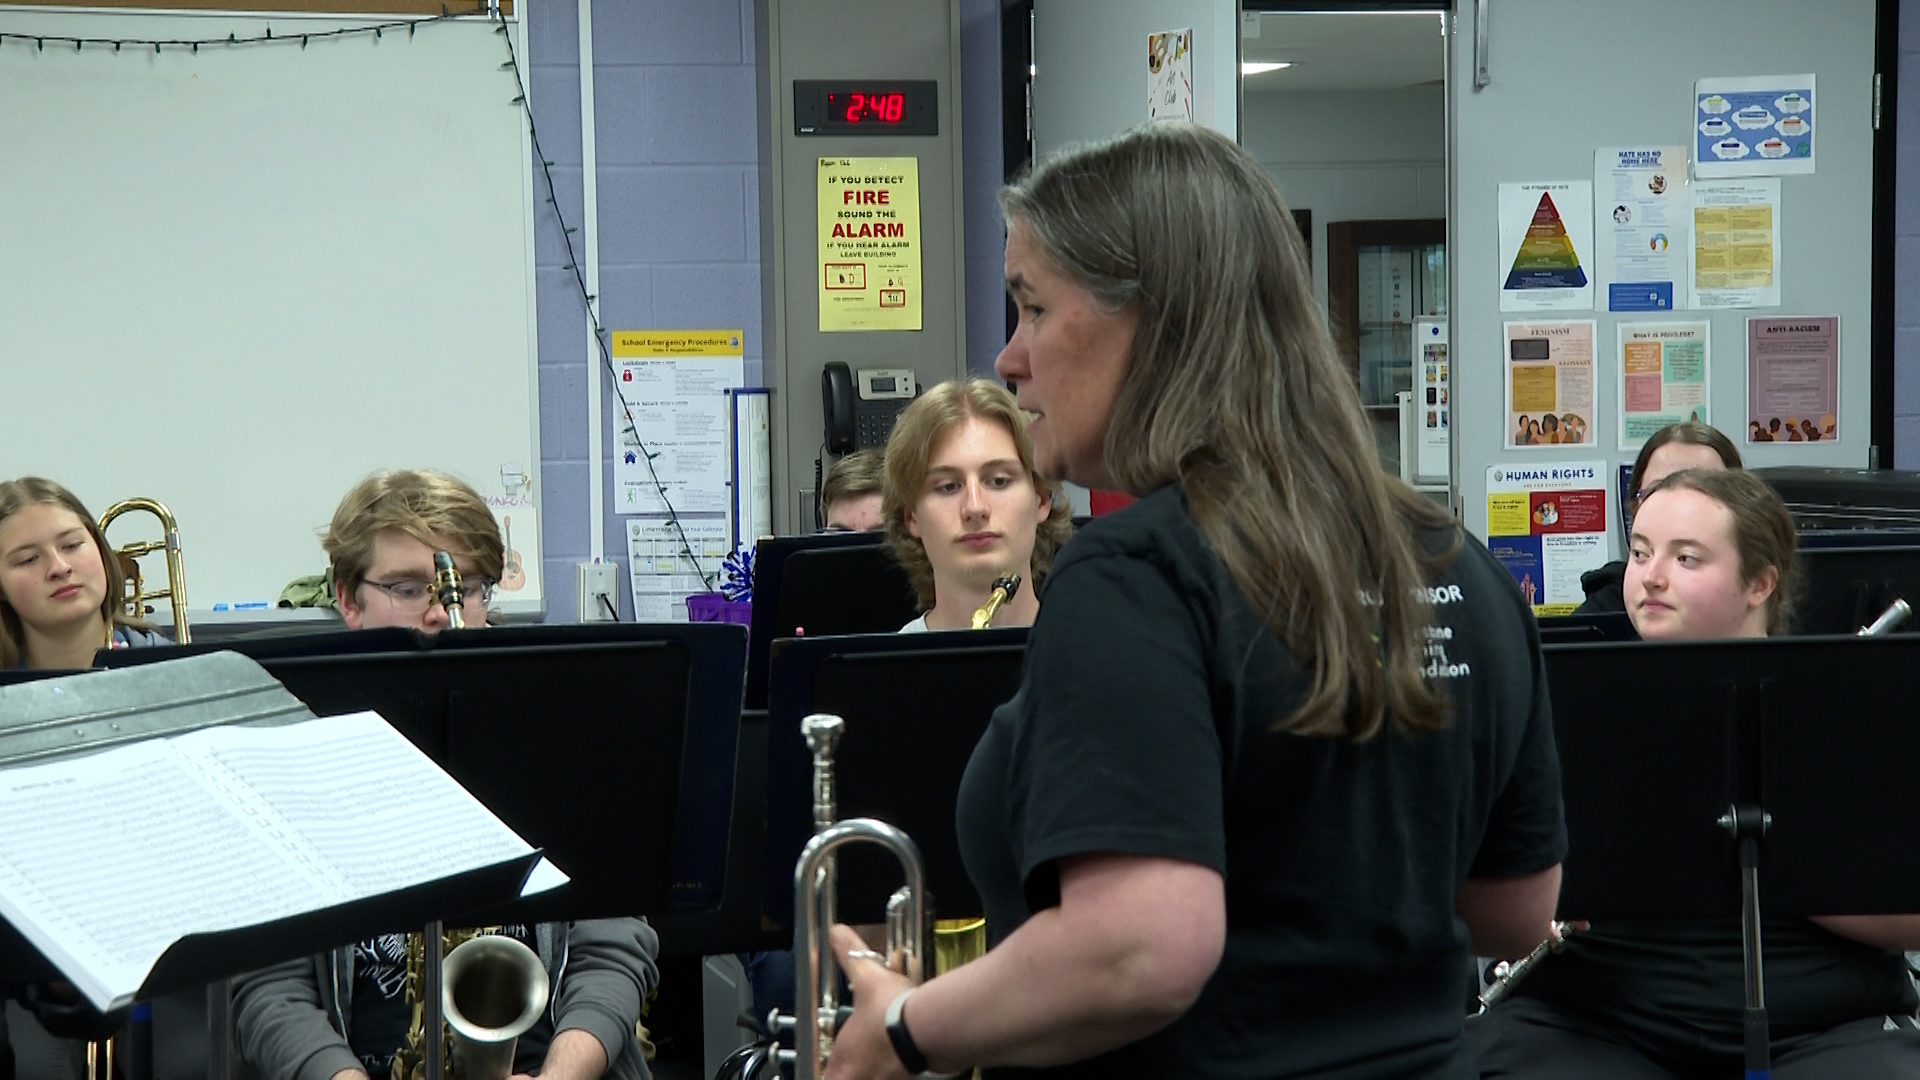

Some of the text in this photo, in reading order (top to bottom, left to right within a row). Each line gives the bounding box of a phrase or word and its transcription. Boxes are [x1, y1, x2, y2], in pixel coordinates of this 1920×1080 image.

[846, 94, 903, 122] 2:48
[828, 176, 904, 184] IF YOU DETECT
[843, 190, 890, 205] FIRE
[837, 210, 896, 218] SOUND THE
[831, 222, 904, 238] ALARM
[647, 339, 686, 348] Emergency
[688, 338, 727, 346] Procedures
[1506, 467, 1594, 481] HUMAN RIGHTS
